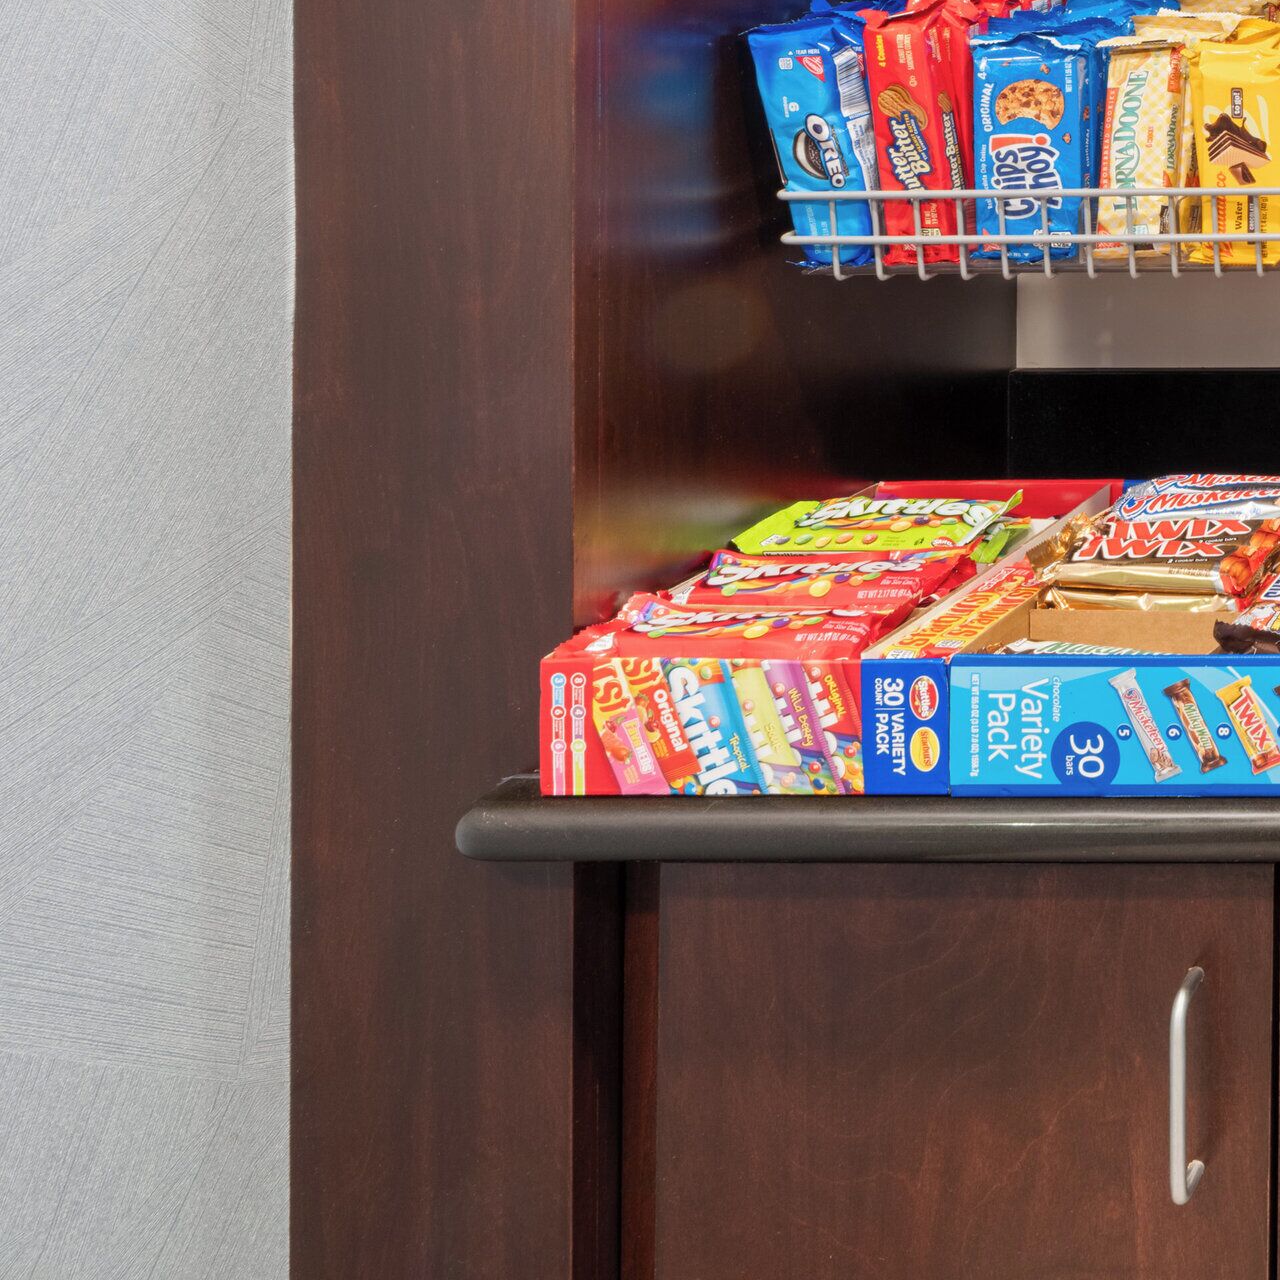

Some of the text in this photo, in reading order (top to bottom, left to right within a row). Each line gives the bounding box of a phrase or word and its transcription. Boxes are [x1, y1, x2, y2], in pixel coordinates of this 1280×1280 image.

[979, 82, 995, 133] ORIGINAL
[805, 113, 846, 188] OREO
[1235, 202, 1243, 230] Wafer
[797, 497, 995, 527] Skittles
[653, 688, 689, 753] Original
[874, 677, 890, 755] COUNT PACK
[883, 677, 906, 776] 30 VARIETY
[917, 680, 933, 718] Skittles
[987, 693, 1017, 762] Pack
[1014, 677, 1050, 779] Variety
[1052, 676, 1062, 722] chocolate
[1229, 685, 1275, 752] TWIX
[1065, 755, 1075, 776] bars
[1069, 734, 1105, 778] 30
